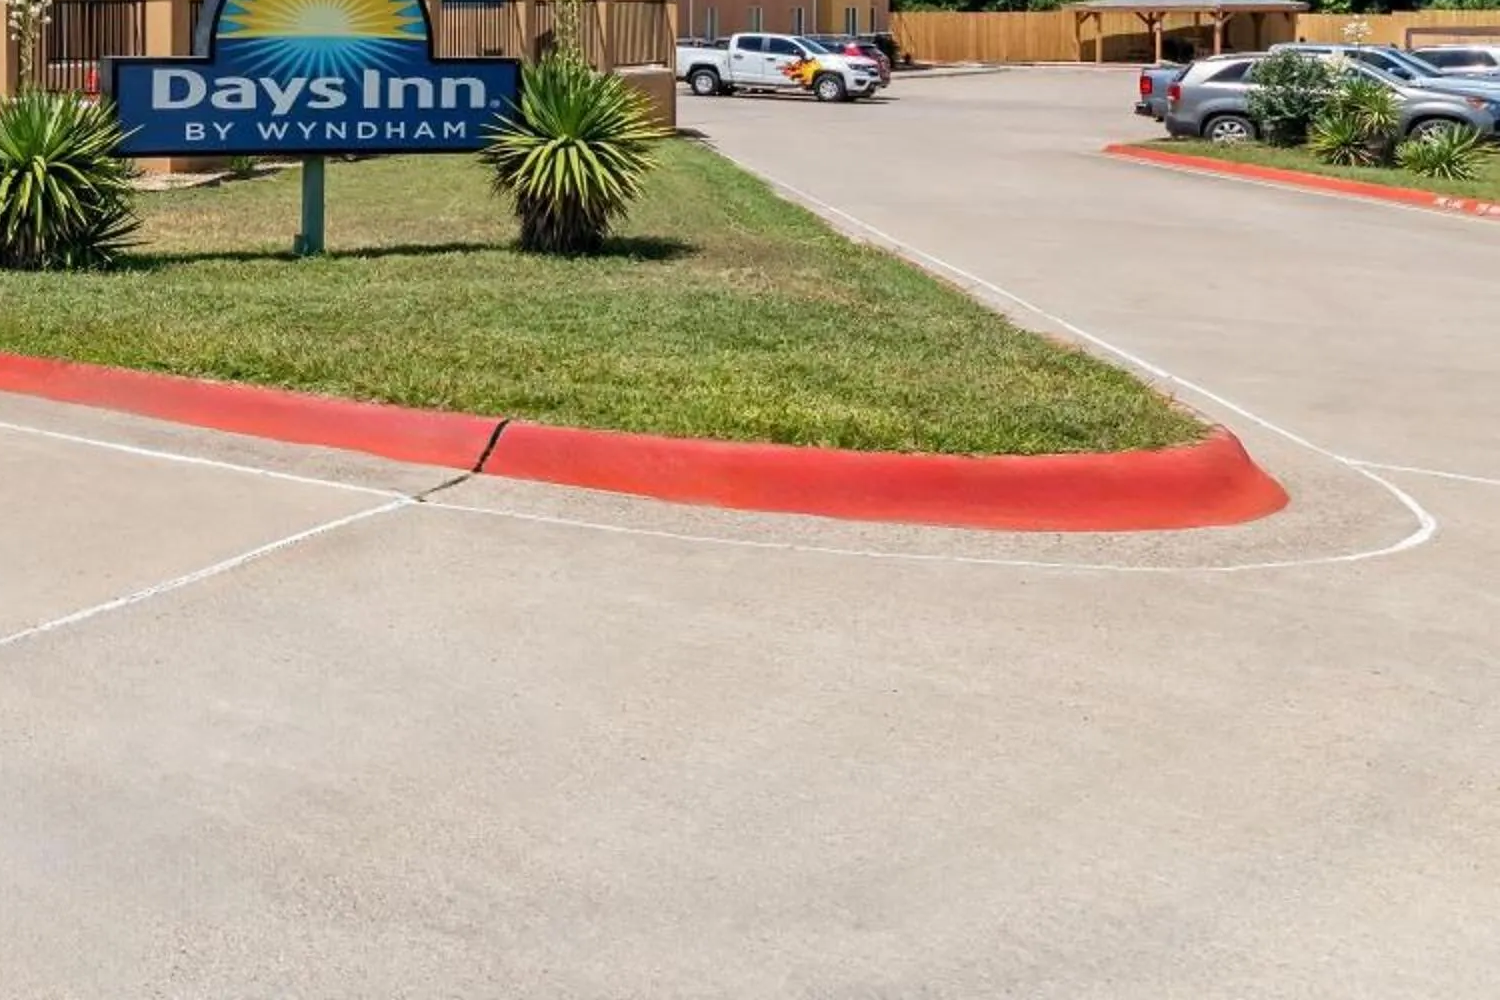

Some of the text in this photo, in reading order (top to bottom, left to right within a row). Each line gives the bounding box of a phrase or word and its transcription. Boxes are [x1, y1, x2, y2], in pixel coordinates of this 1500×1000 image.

[152, 69, 487, 116] Days Inn
[185, 121, 467, 141] BY WYNDHAM
